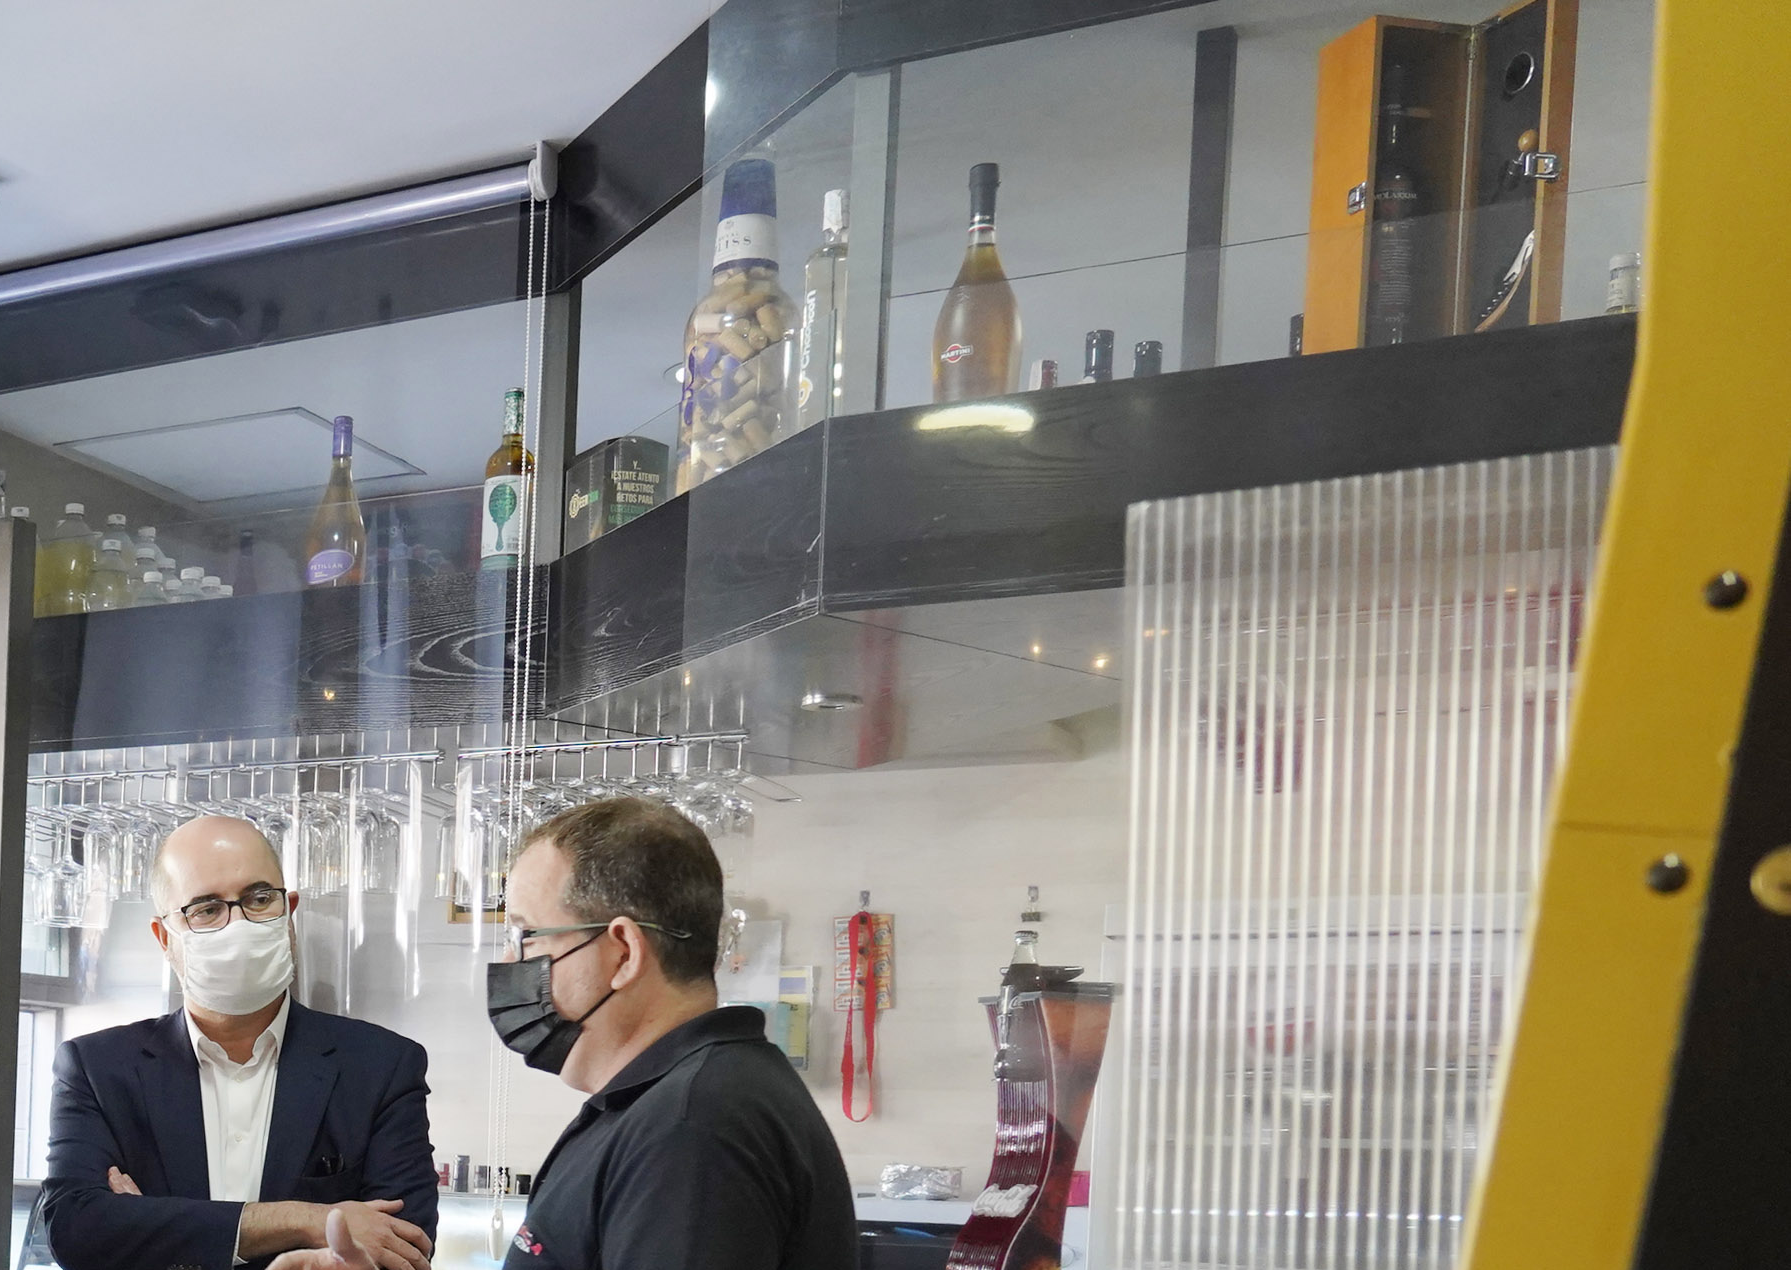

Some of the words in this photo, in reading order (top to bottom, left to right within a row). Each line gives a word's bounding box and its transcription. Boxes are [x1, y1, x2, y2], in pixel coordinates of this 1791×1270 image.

[941, 346, 973, 360] MARTINI
[616, 482, 622, 491] A
[622, 482, 655, 494] NUESTROS
[616, 492, 638, 503] RETOS
[637, 494, 654, 505] PARA
